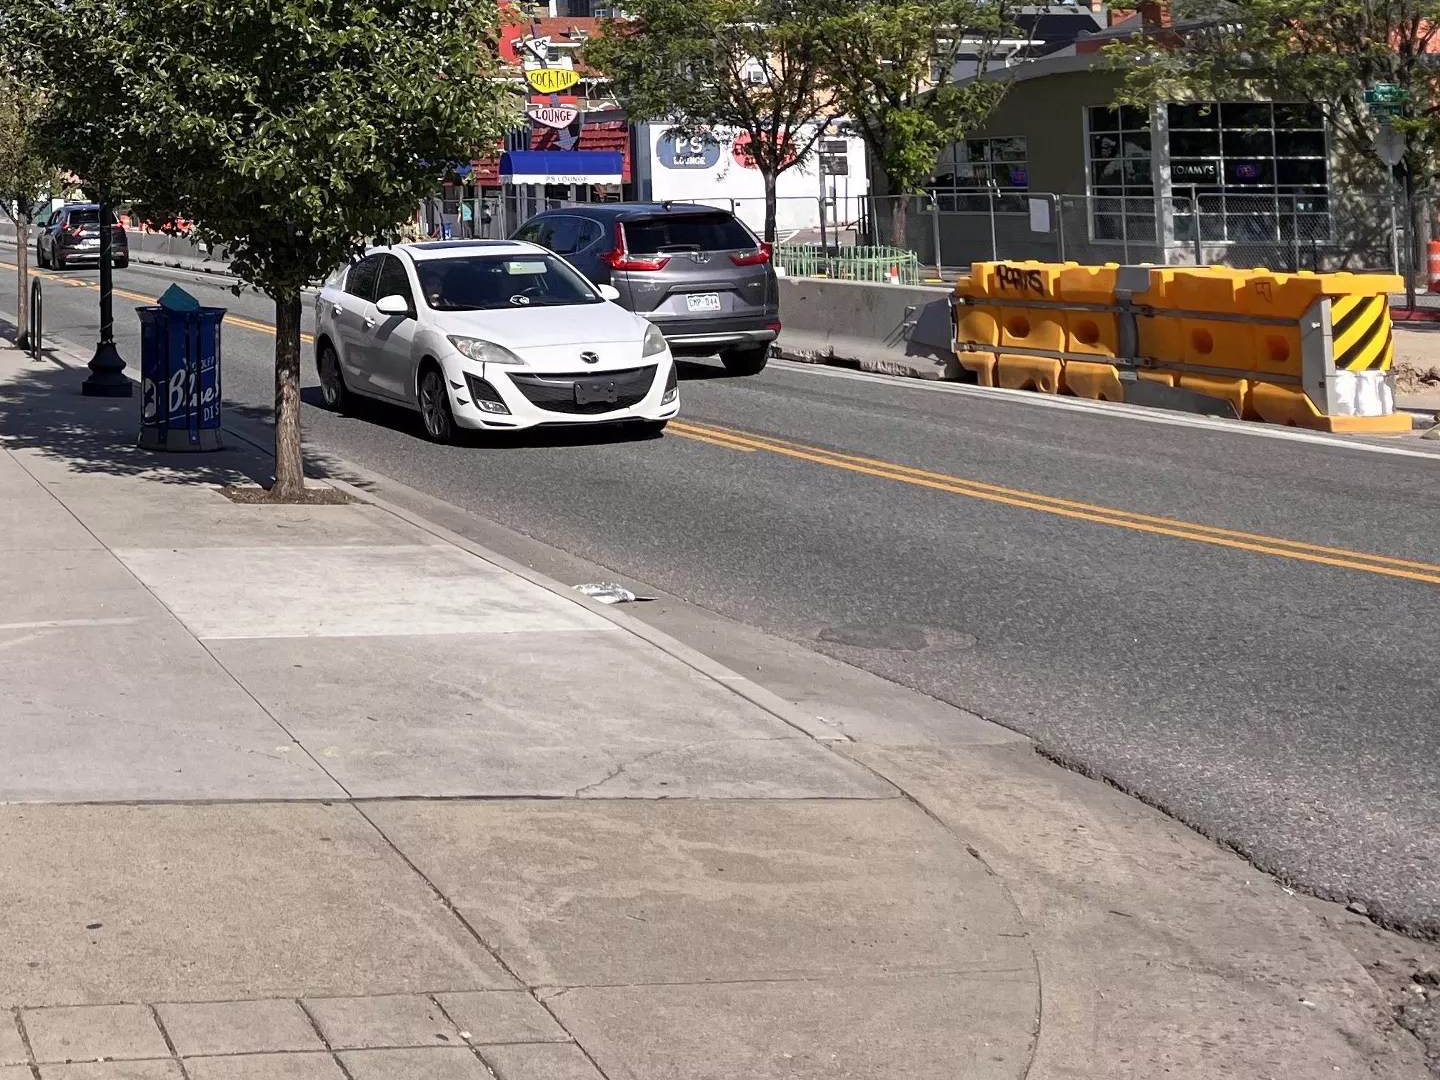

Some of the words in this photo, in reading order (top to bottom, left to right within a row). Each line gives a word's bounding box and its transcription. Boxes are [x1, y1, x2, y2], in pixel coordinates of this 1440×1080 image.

[534, 39, 548, 51] PS
[530, 71, 572, 89] COCKTAIL
[535, 109, 572, 123] LOUNGE
[675, 136, 703, 154] PS
[673, 156, 707, 165] LOUNGE
[1171, 165, 1215, 175] TOMMY'S
